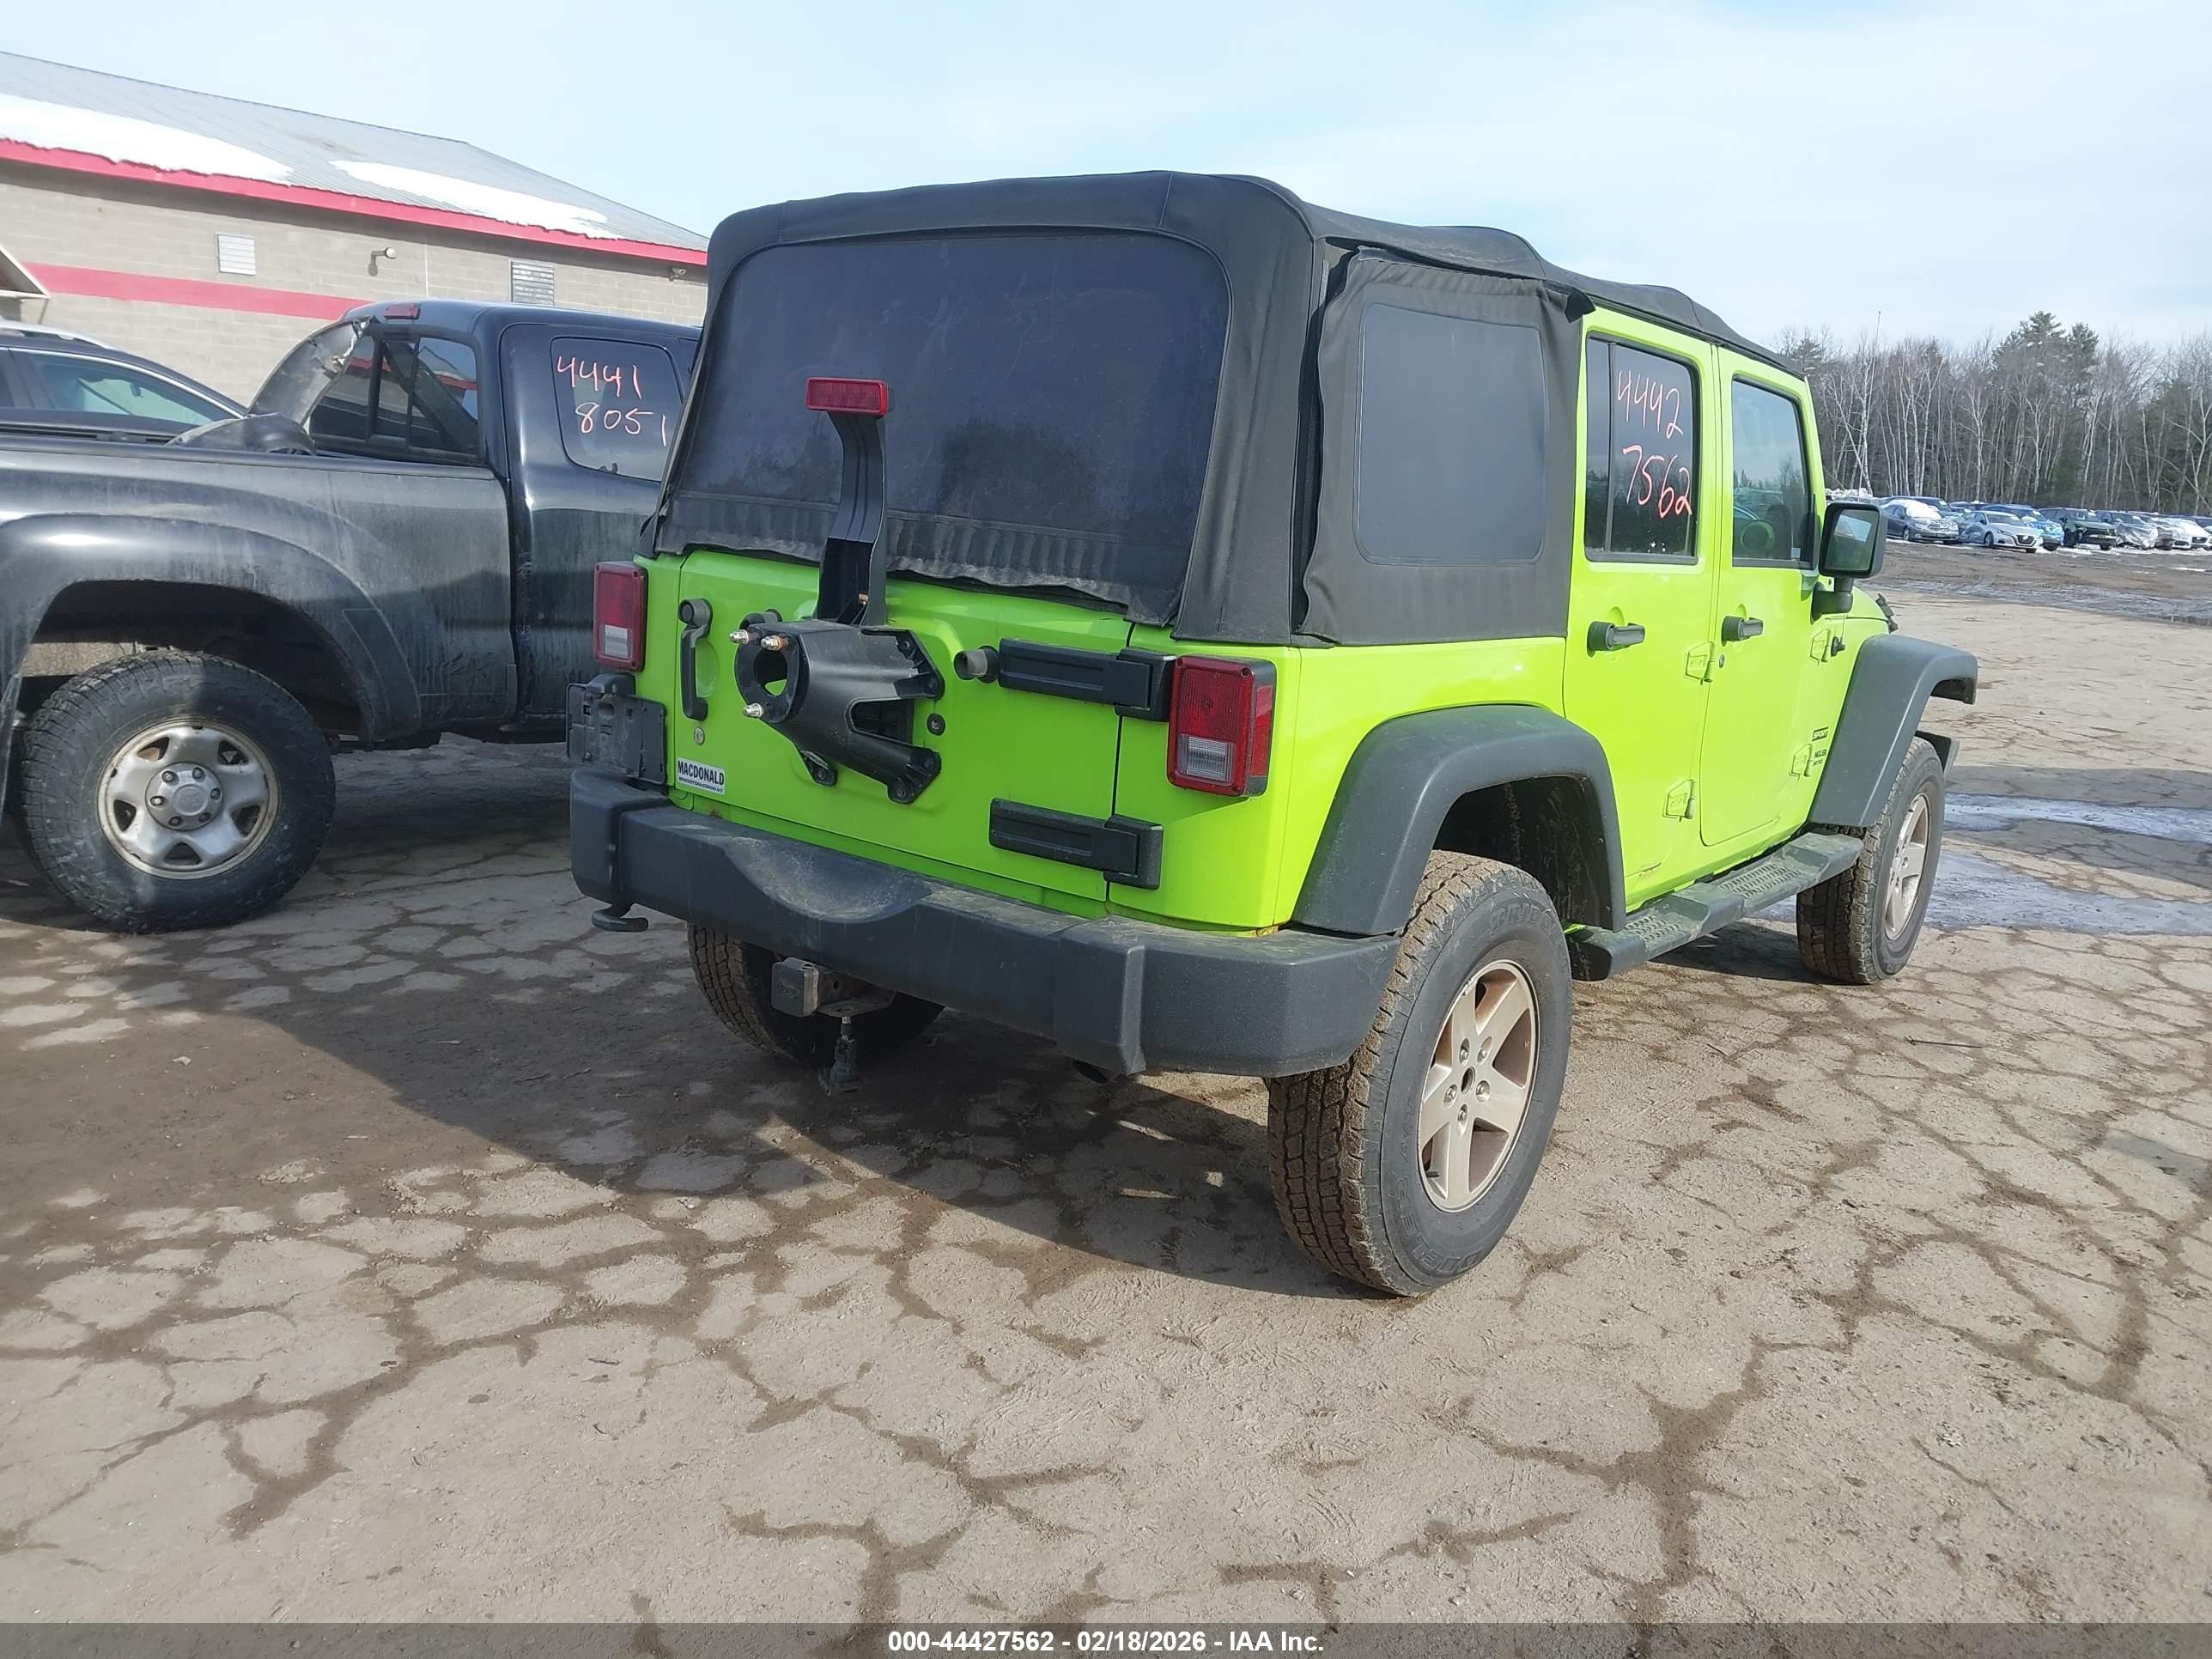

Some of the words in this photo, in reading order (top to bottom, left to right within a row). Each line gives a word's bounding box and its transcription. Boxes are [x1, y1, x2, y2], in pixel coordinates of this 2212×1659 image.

[557, 355, 642, 399] 4441
[574, 401, 667, 447] 8051
[1617, 369, 1684, 440] 4442
[1621, 444, 1693, 519] 7562
[677, 760, 725, 786] MACDONALD
